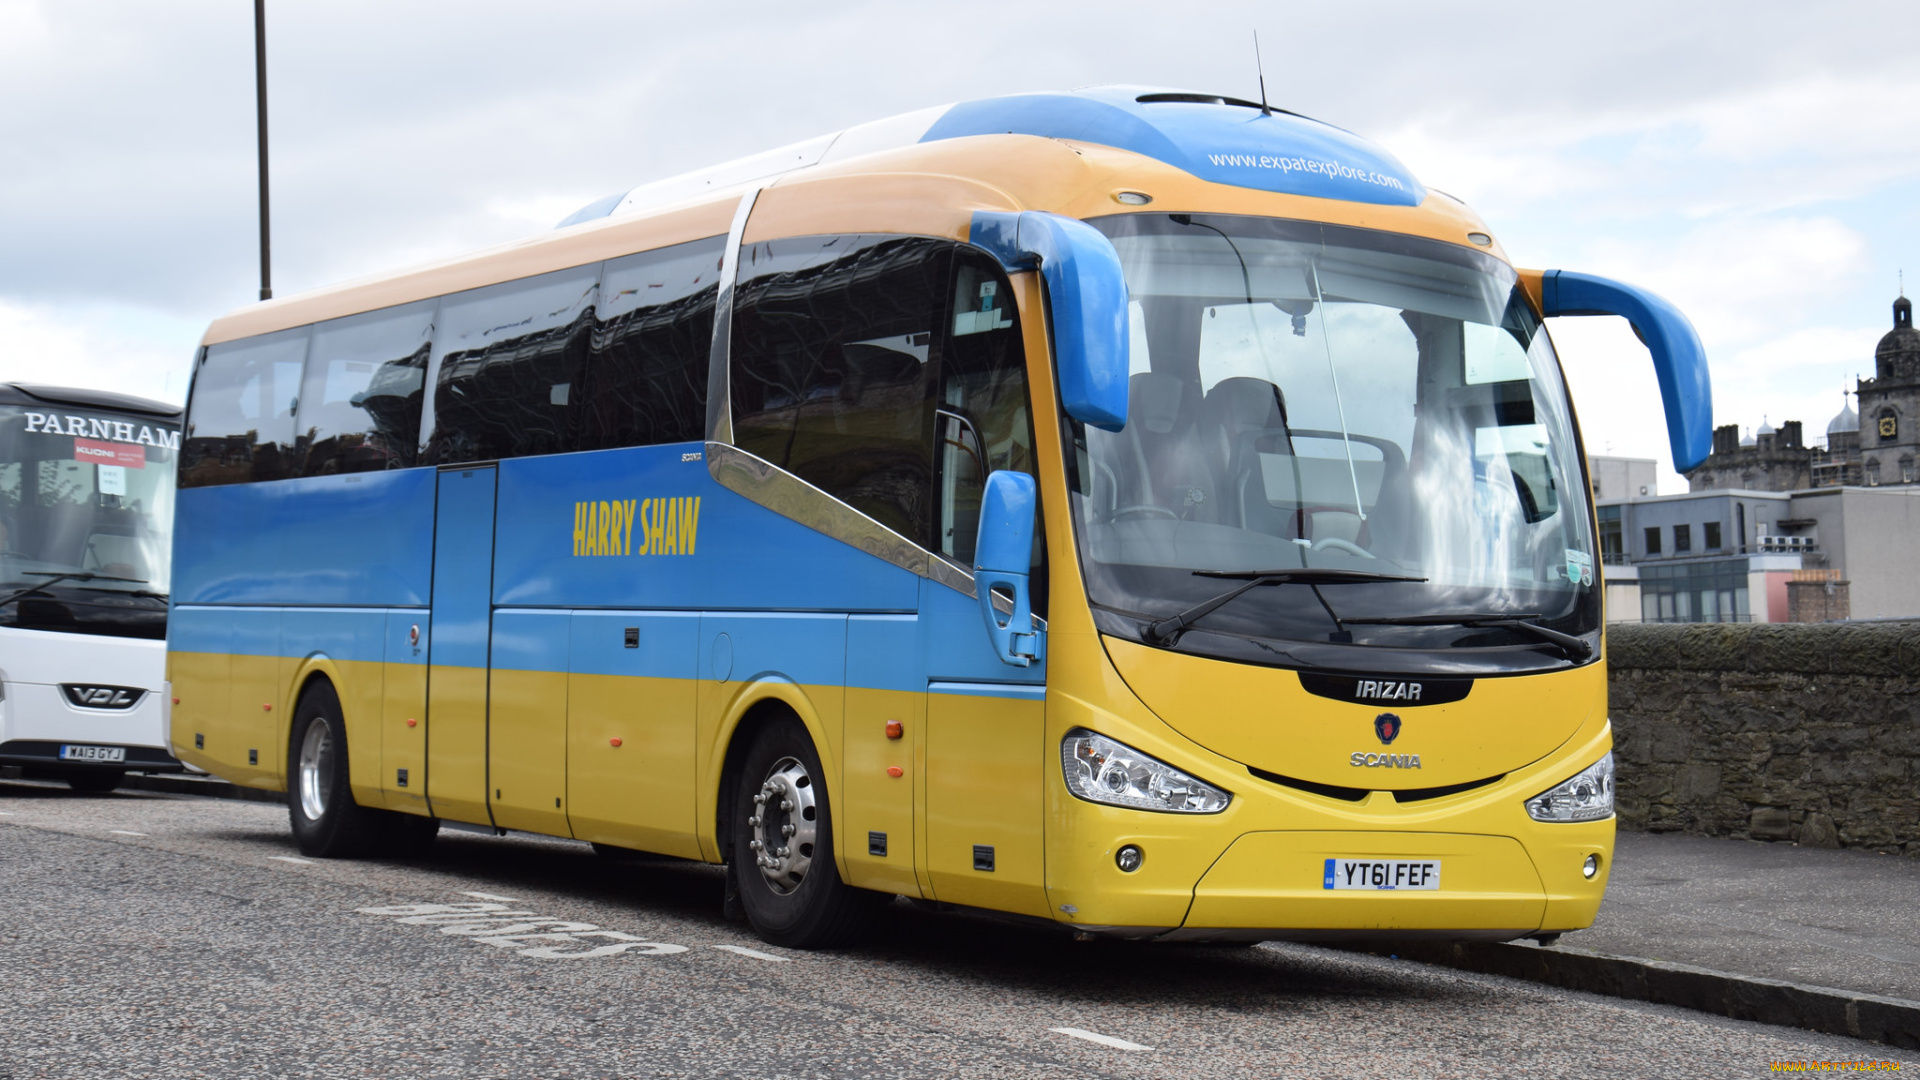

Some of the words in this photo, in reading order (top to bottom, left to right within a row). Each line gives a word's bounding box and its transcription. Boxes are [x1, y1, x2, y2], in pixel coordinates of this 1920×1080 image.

[1208, 153, 1403, 190] www.expatexplore.com
[25, 412, 181, 450] PARNHAM
[77, 446, 114, 457] KUONI
[573, 499, 636, 556] HARRY
[639, 496, 700, 556] SHAW
[72, 687, 132, 705] VDL
[1356, 681, 1422, 700] IRIZAR
[98, 748, 121, 760] GYJ
[1350, 752, 1421, 769] SCANIA
[1345, 863, 1390, 886] YT61
[1396, 863, 1433, 886] FEF
[354, 903, 690, 959] BUSES
